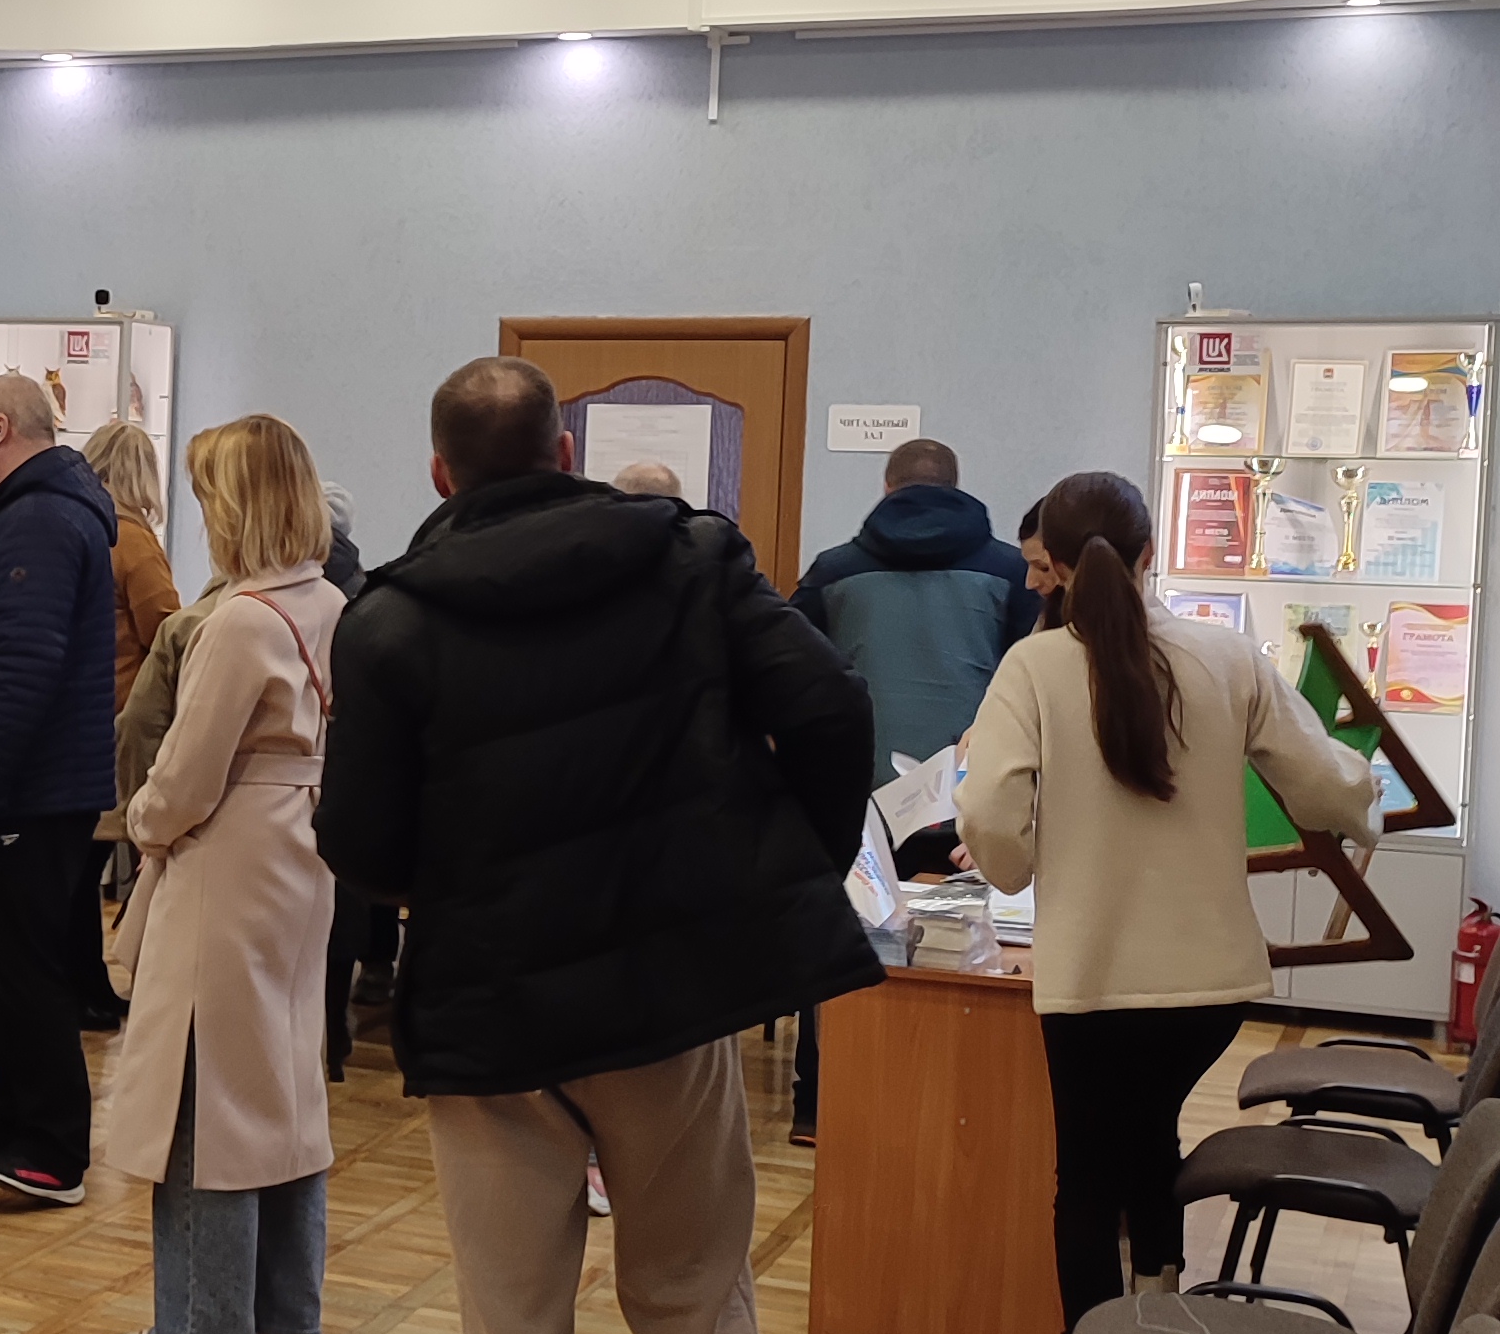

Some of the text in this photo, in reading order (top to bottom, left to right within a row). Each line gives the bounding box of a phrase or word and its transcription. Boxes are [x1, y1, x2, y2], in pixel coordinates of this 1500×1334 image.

[840, 418, 909, 428] ЧИТАЛЬНЫЙ
[864, 431, 884, 440] ЗАЛ
[1190, 489, 1238, 502] ДИПЛОМ
[1378, 496, 1429, 506] ДИПЛОМ
[1402, 632, 1454, 642] ГРАМОТА
